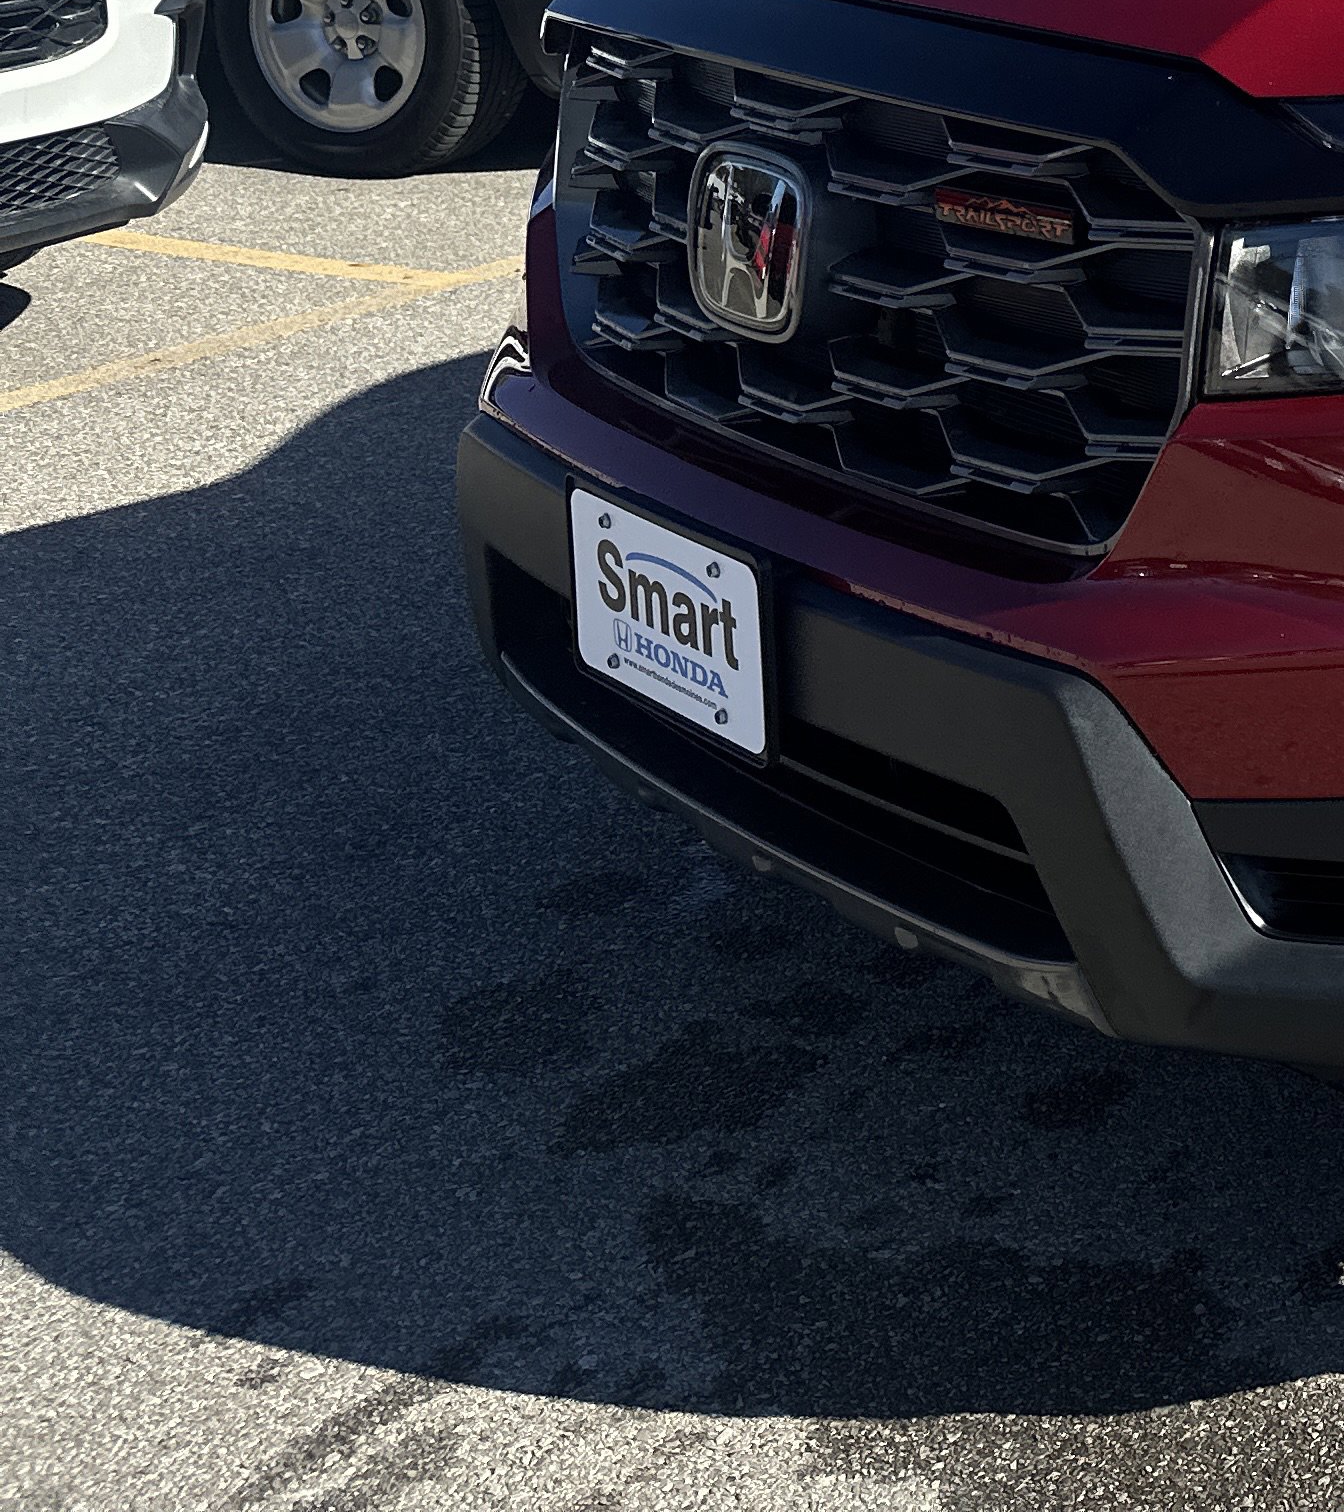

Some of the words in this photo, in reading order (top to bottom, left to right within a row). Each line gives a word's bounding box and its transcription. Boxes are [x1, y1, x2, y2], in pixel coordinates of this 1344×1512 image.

[937, 202, 1073, 239] TRAILSPORT
[597, 539, 739, 671] Smart
[634, 632, 729, 699] HONDA
